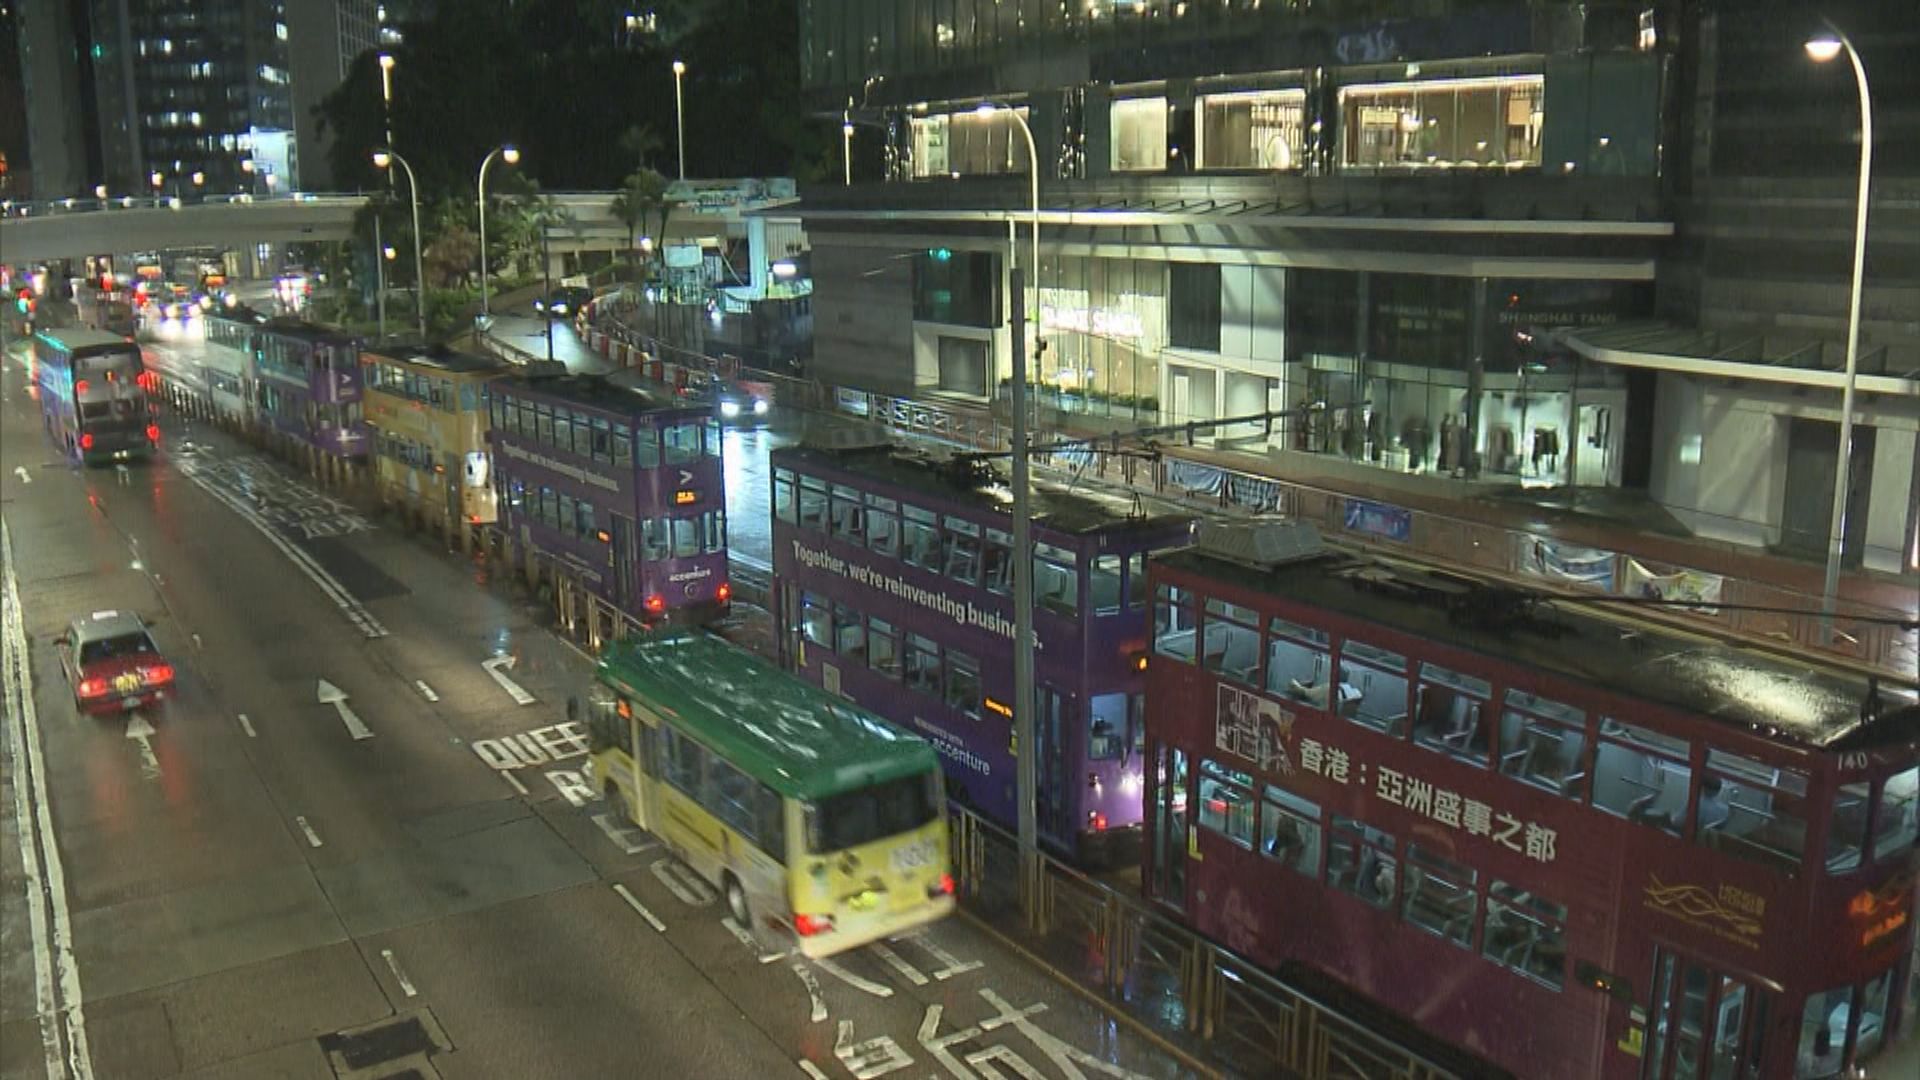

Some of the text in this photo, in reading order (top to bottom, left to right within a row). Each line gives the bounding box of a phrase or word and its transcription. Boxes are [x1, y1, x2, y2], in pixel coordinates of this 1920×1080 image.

[792, 540, 848, 577] Together,
[848, 563, 883, 588] we're
[884, 575, 966, 625] reinventing
[932, 738, 990, 776] accenture
[1837, 751, 1868, 771] 140
